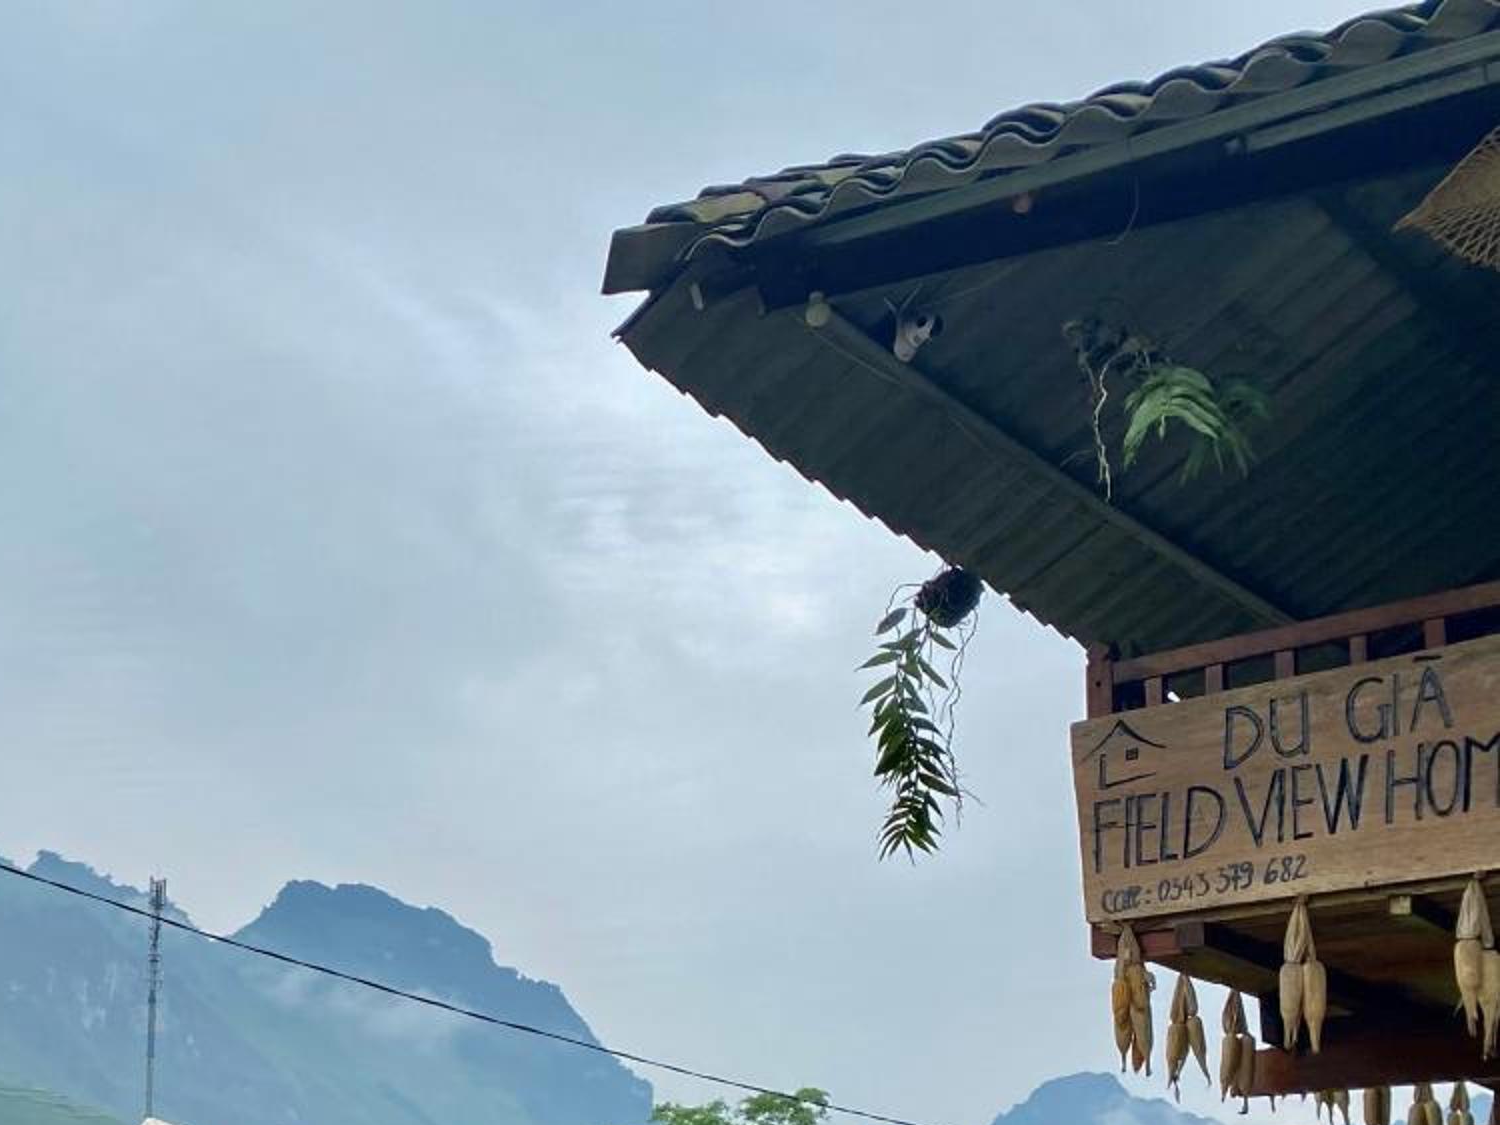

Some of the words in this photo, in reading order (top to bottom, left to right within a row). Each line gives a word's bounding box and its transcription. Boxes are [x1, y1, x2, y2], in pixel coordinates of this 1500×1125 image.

[1223, 691, 1311, 770] DU
[1093, 785, 1227, 874] FIELD
[1233, 754, 1370, 848] VIEW
[1263, 853, 1309, 885] 682
